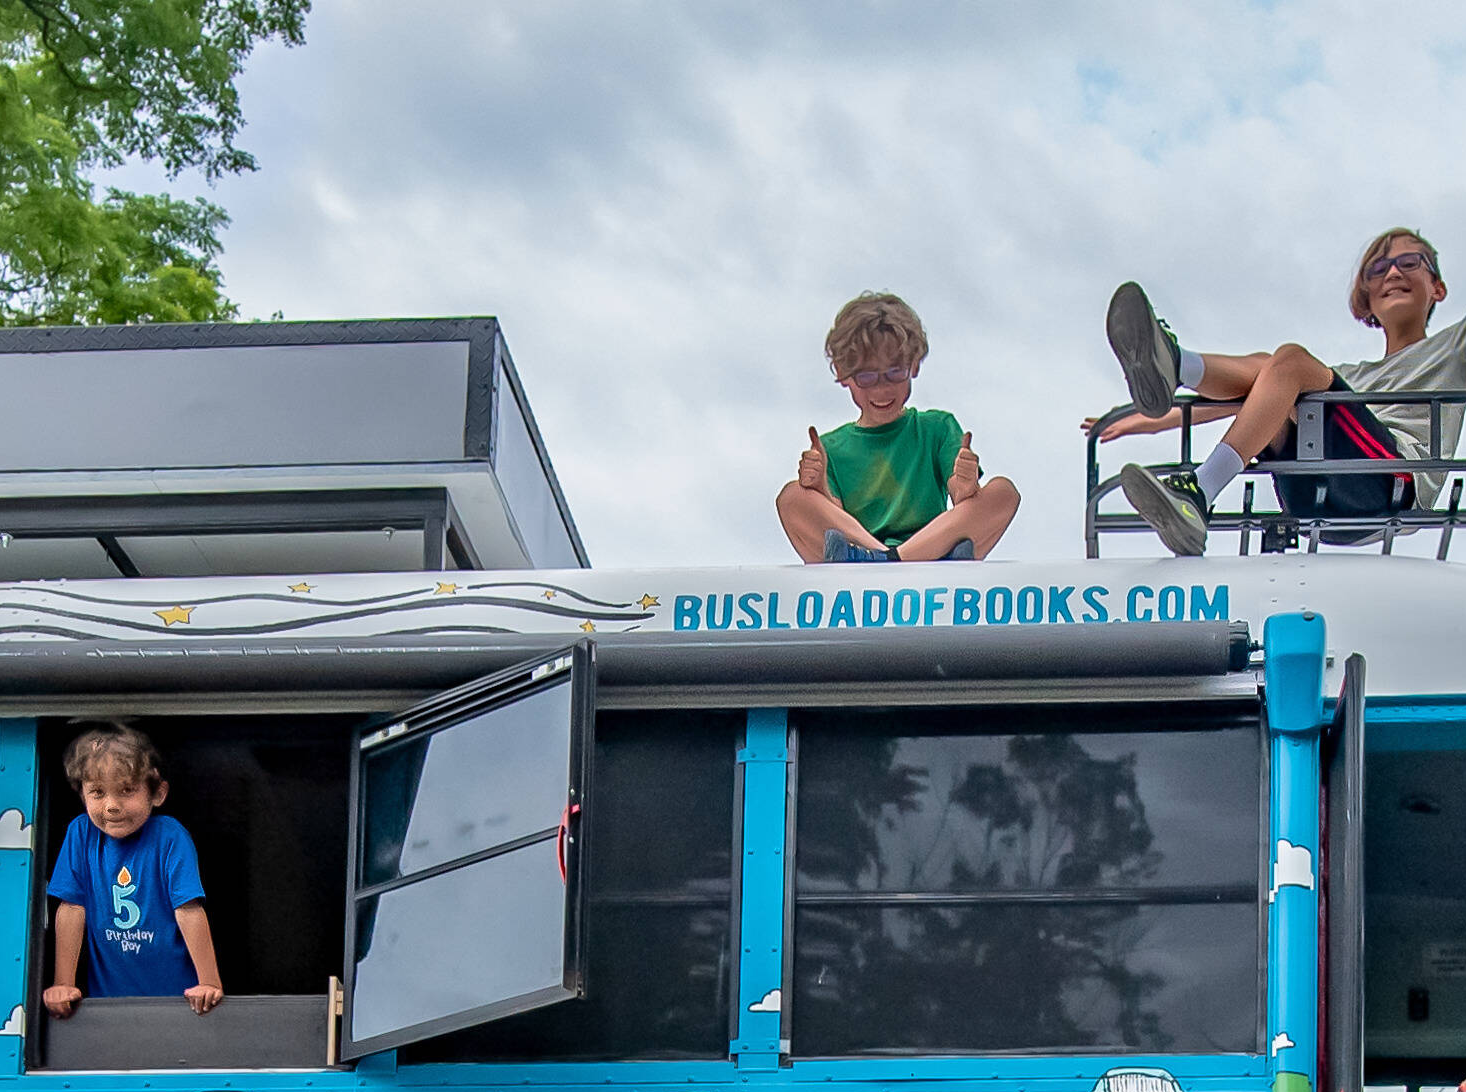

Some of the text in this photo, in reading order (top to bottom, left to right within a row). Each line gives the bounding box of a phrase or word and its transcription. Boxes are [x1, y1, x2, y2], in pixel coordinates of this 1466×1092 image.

[673, 584, 1230, 631] BUSLOADOFBOOKS.COM
[113, 884, 140, 929] 5
[106, 929, 154, 943] Birthday
